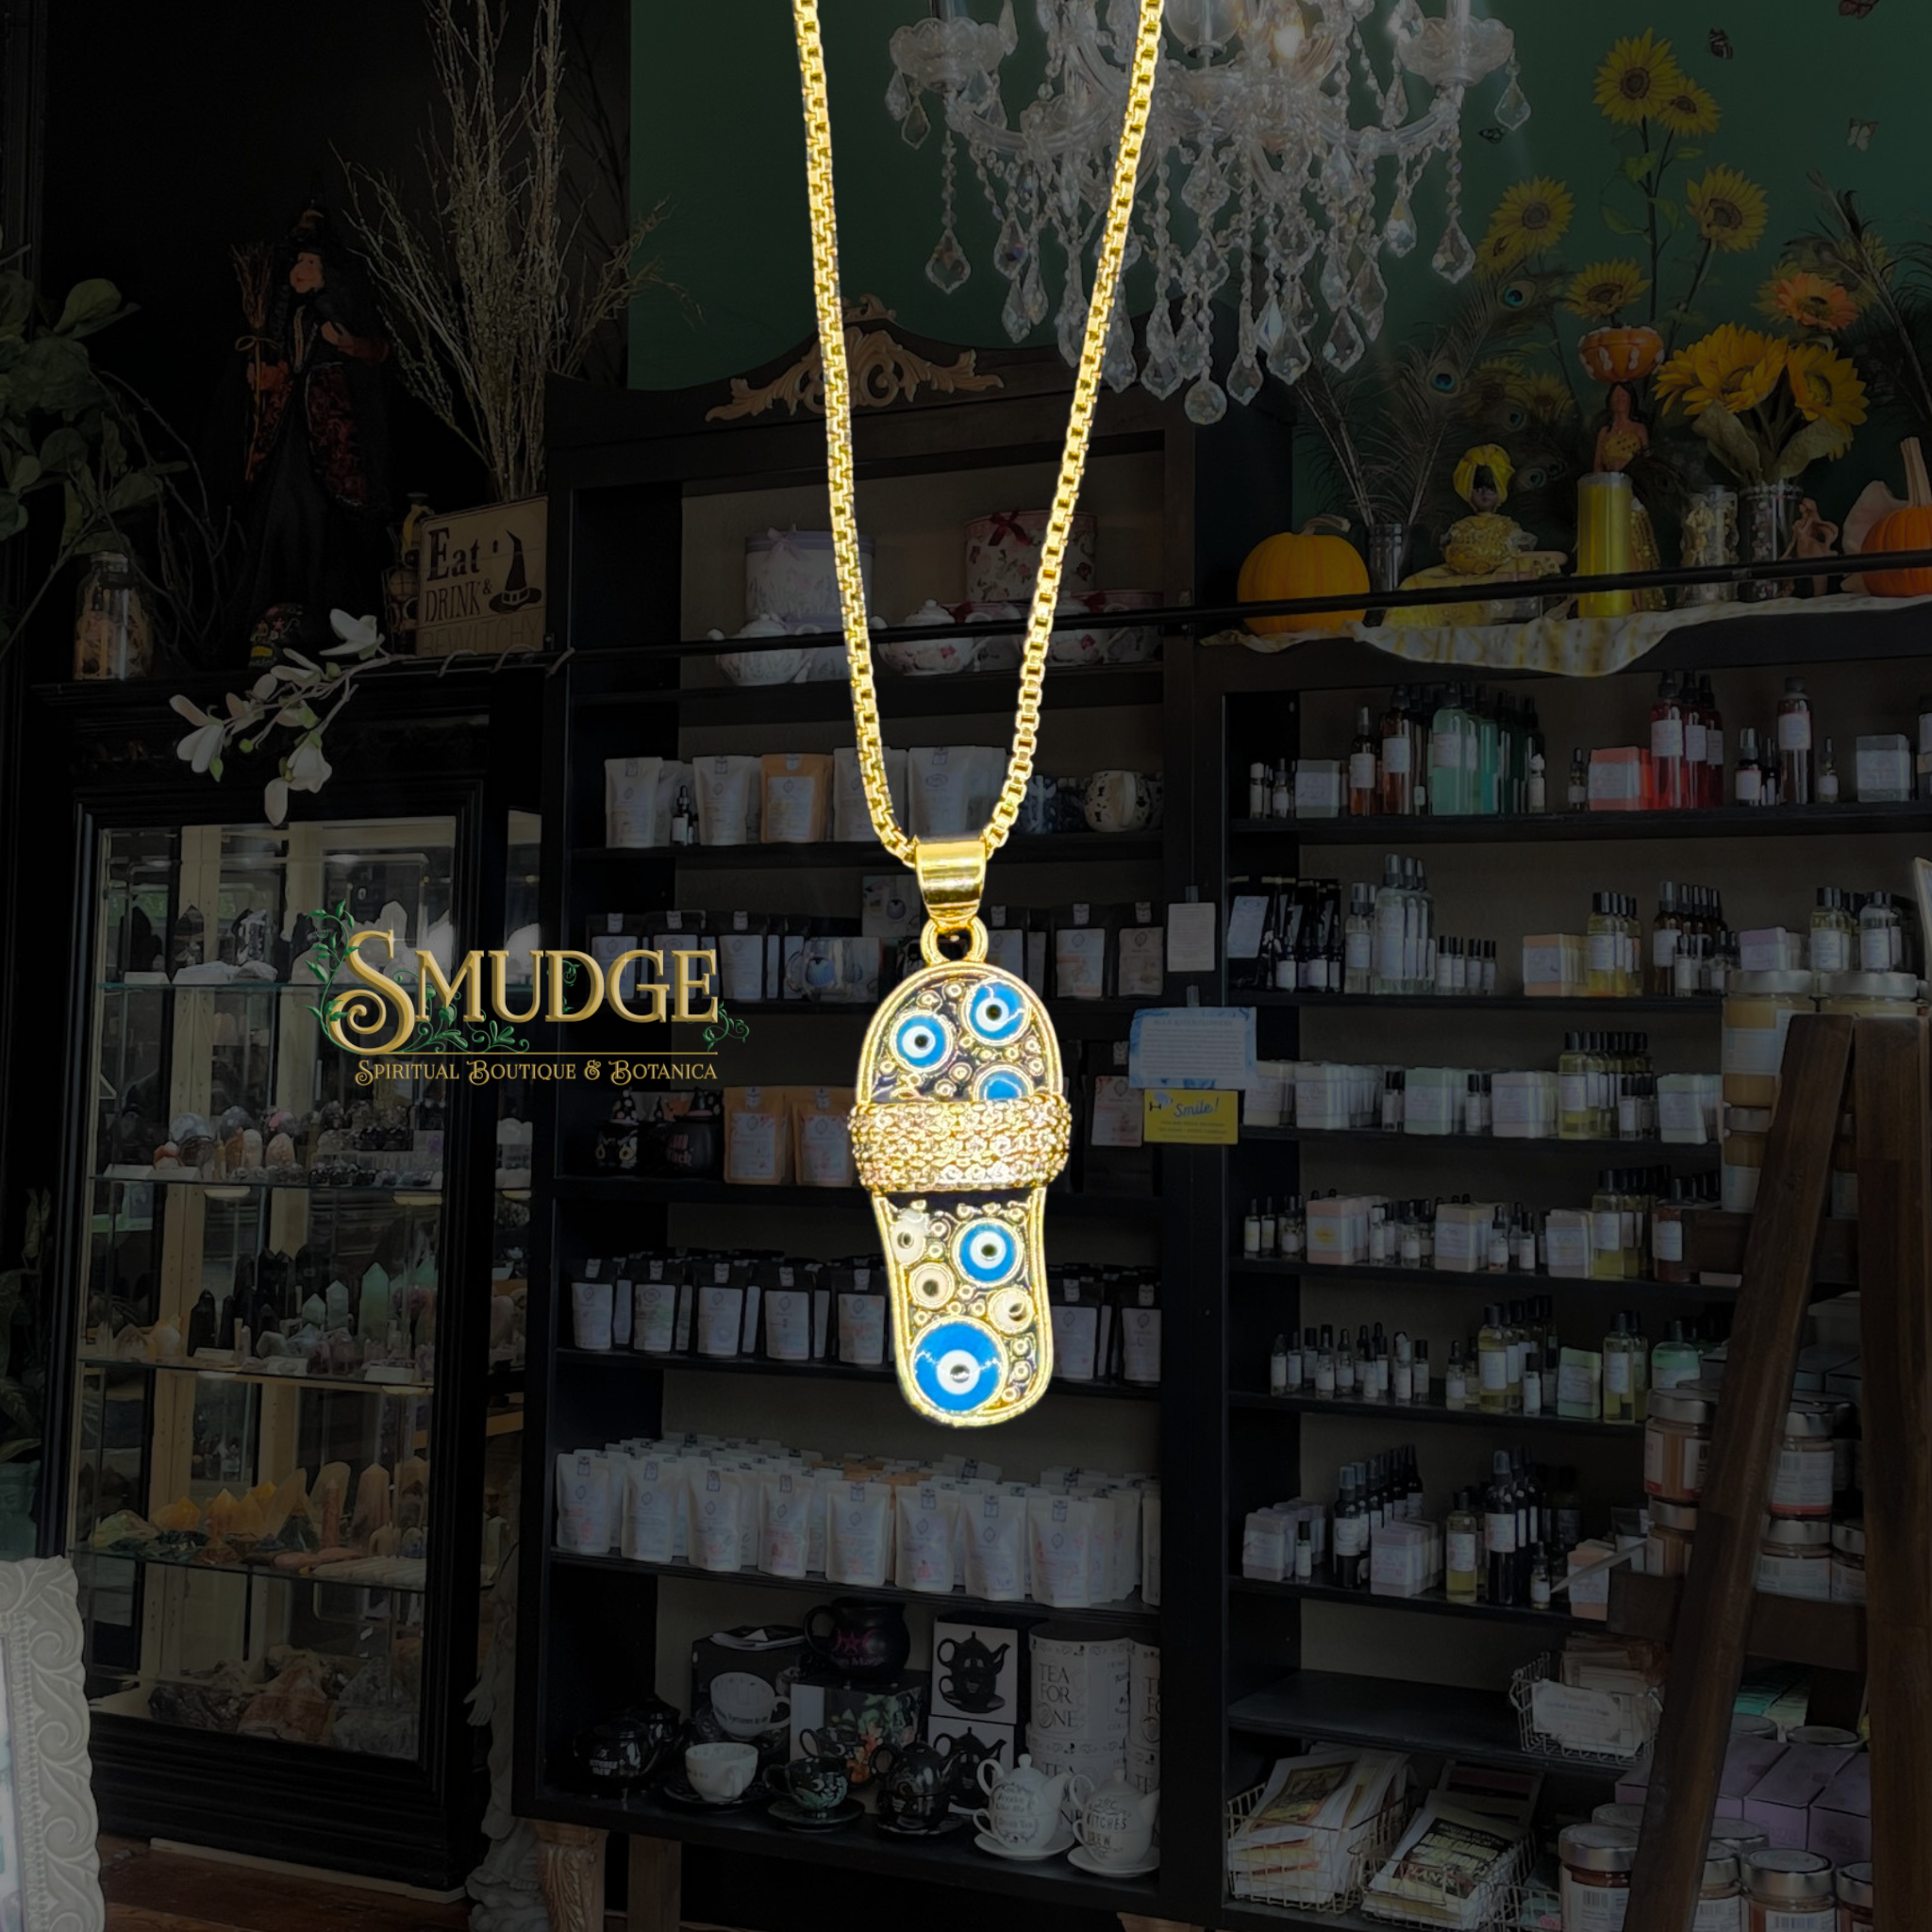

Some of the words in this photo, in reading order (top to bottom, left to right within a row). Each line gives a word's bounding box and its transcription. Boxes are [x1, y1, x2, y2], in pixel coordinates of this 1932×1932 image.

[427, 527, 480, 581] Eat
[425, 581, 480, 623] DRINK
[482, 578, 492, 595] &
[1174, 1097, 1220, 1118] Smile!
[1039, 1662, 1070, 1685] TEA
[1041, 1683, 1072, 1705] FOR
[1038, 1701, 1081, 1729] ONE
